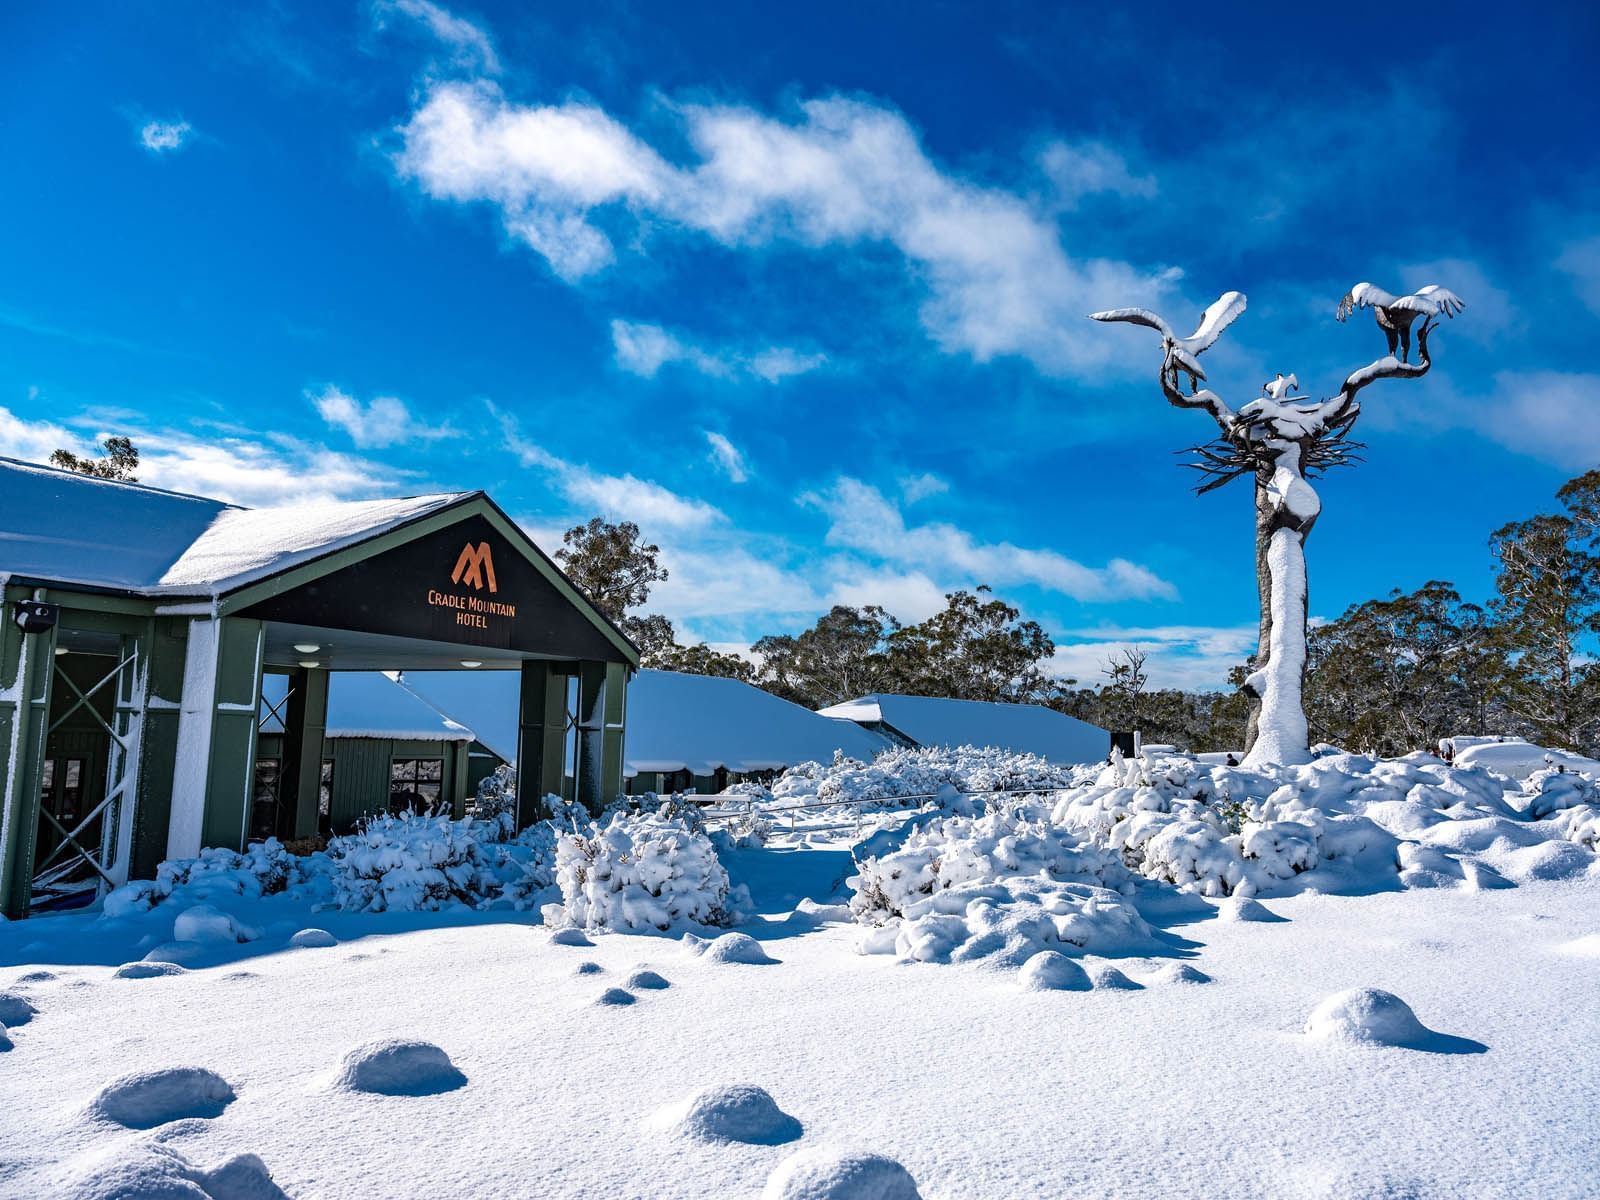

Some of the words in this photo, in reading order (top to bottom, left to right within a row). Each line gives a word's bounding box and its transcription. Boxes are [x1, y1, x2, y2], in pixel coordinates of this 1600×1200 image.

[428, 590, 466, 609] CRADLE
[468, 596, 515, 617] MOUNTAIN
[456, 612, 488, 628] HOTEL
